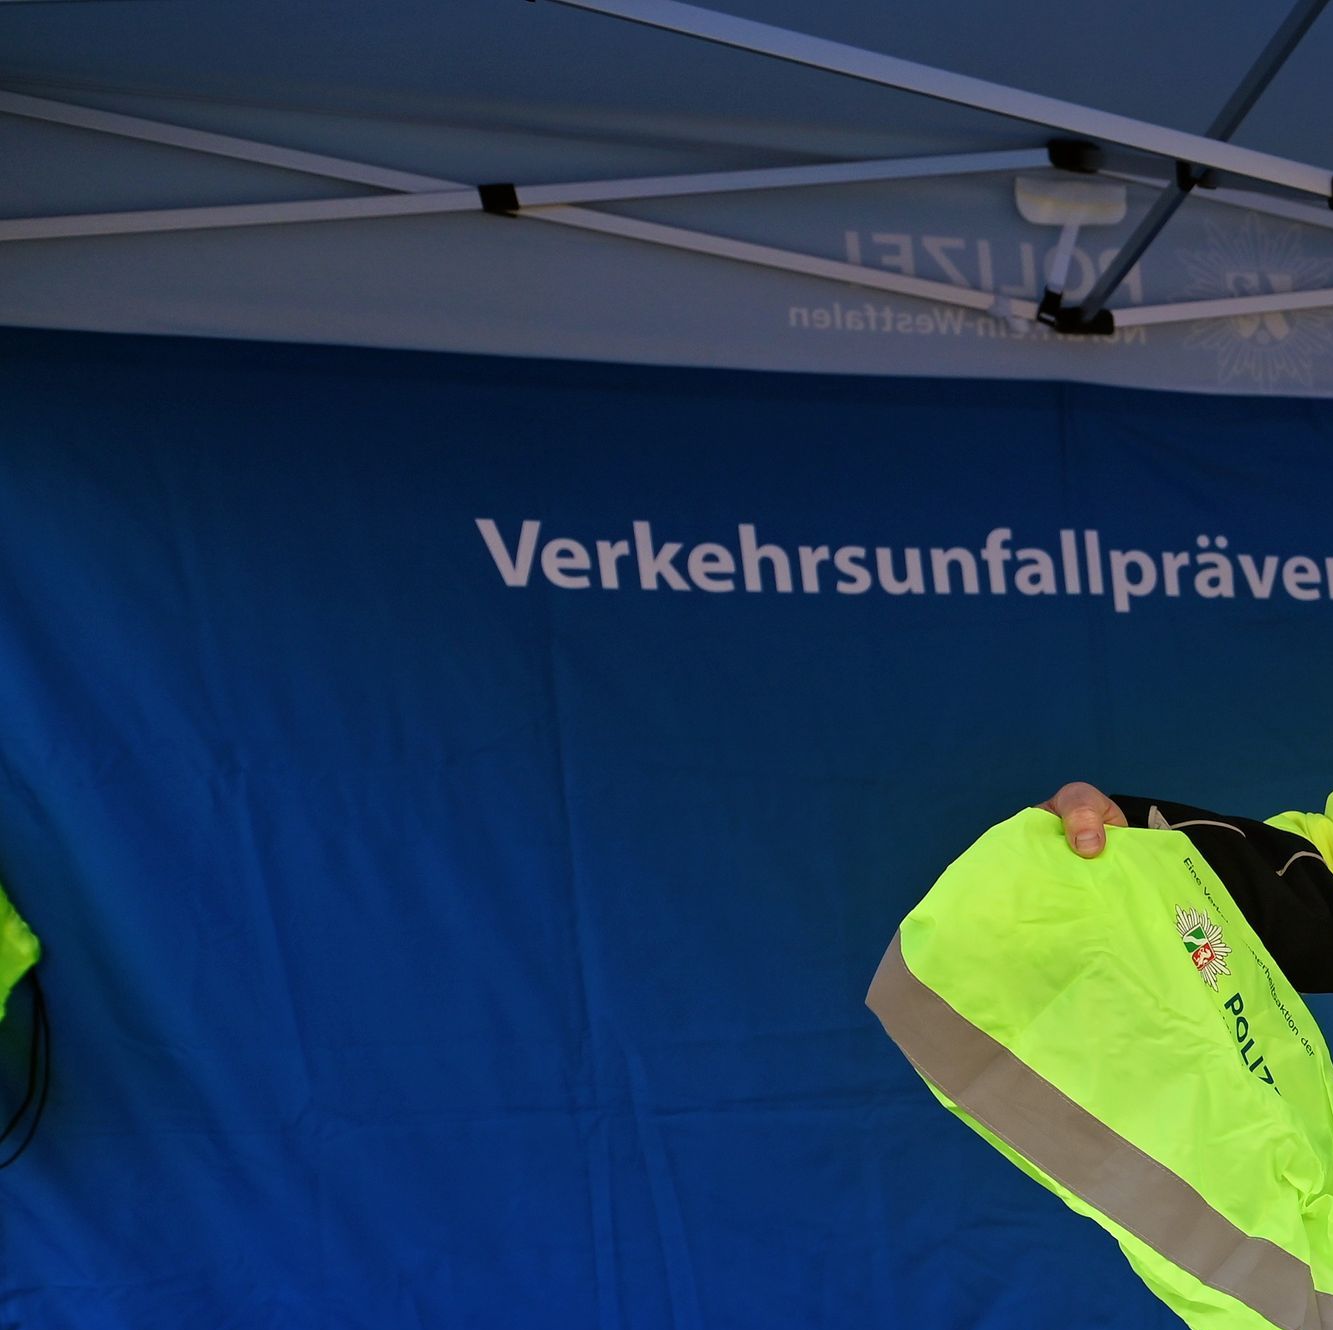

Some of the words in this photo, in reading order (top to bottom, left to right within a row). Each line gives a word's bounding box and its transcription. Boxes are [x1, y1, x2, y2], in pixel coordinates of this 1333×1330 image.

[1183, 857, 1203, 886] Eine
[1300, 1036, 1315, 1057] der
[1223, 992, 1282, 1097] POLIZ
